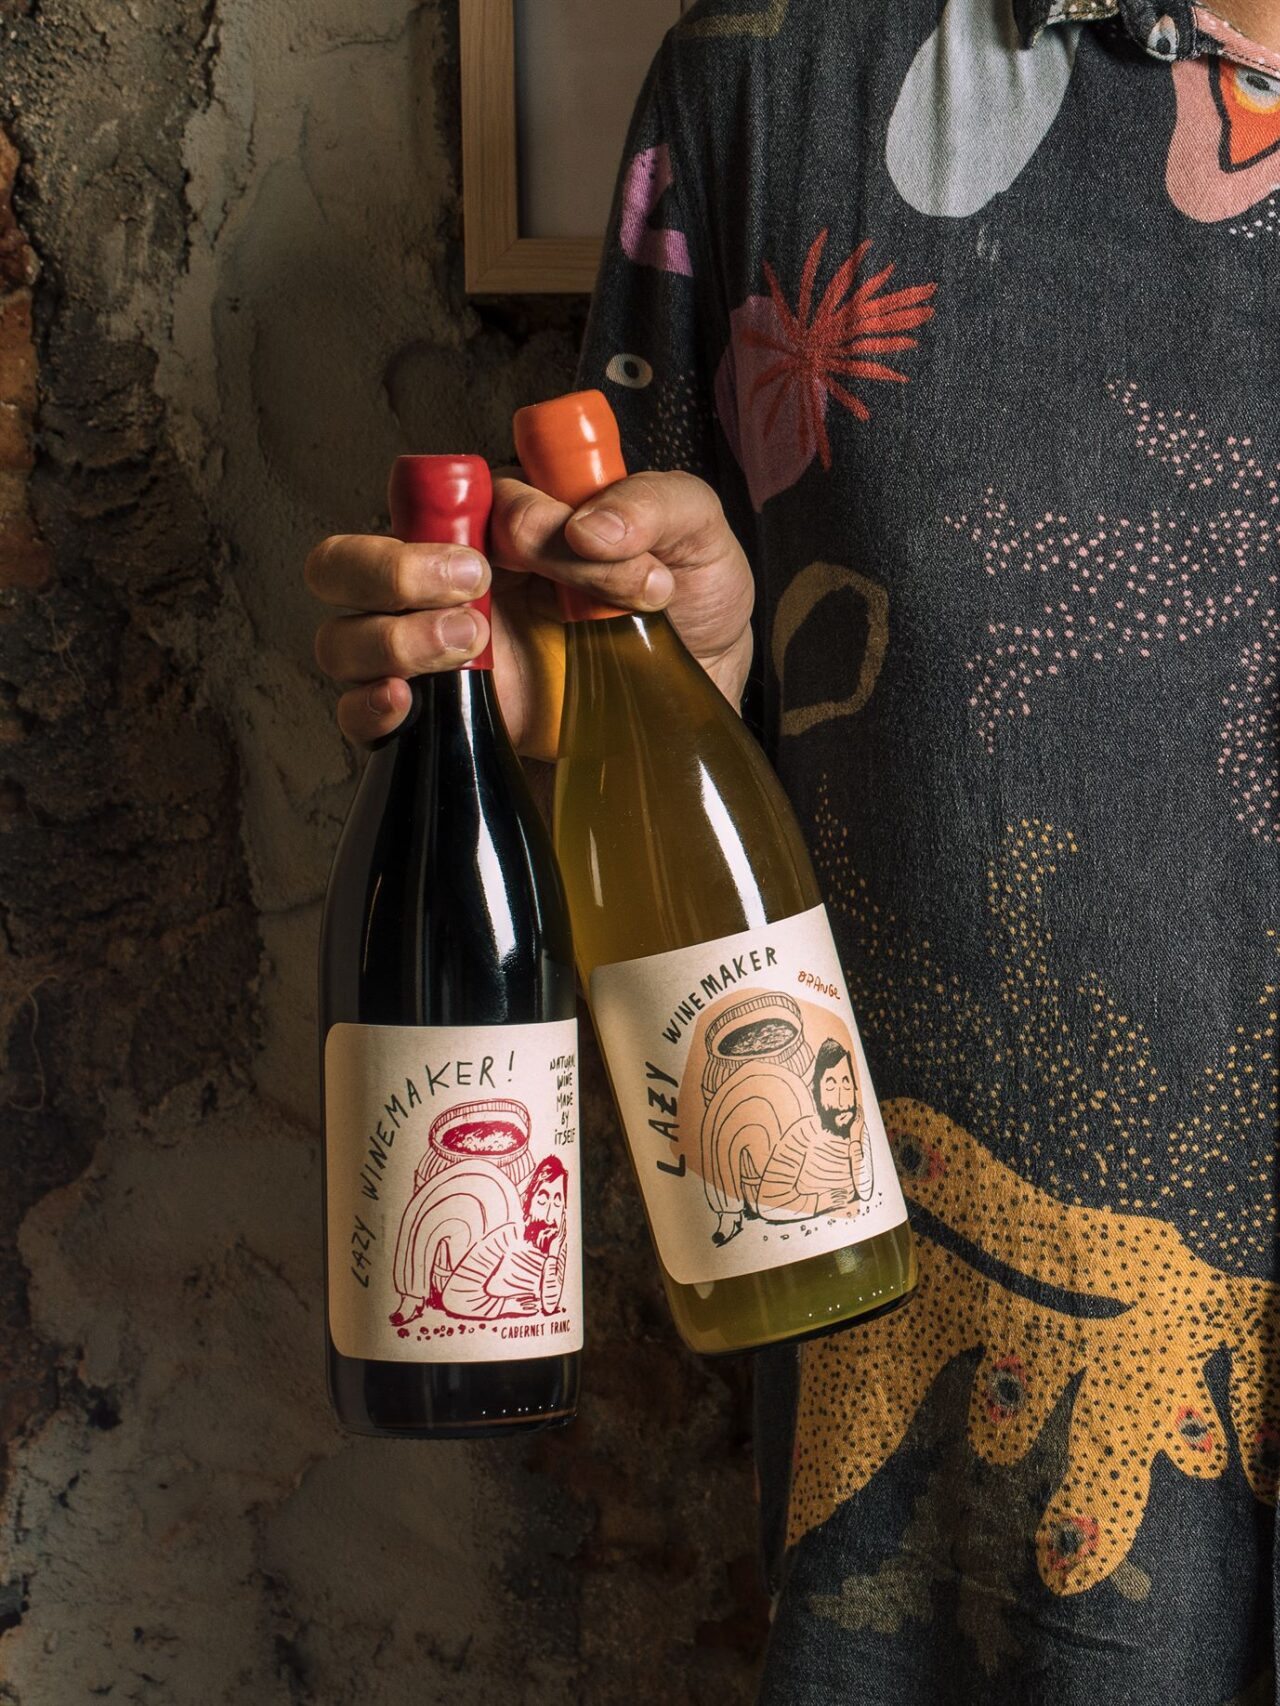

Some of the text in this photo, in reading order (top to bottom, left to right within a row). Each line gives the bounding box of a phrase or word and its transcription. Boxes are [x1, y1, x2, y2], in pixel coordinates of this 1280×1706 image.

[556, 1092, 573, 1112] MADE
[561, 1110, 569, 1128] BY
[647, 1061, 686, 1178] LAZY
[351, 1050, 515, 1289] LAZY WINEMAKER!
[501, 1320, 571, 1339] CABERNET FRANC
